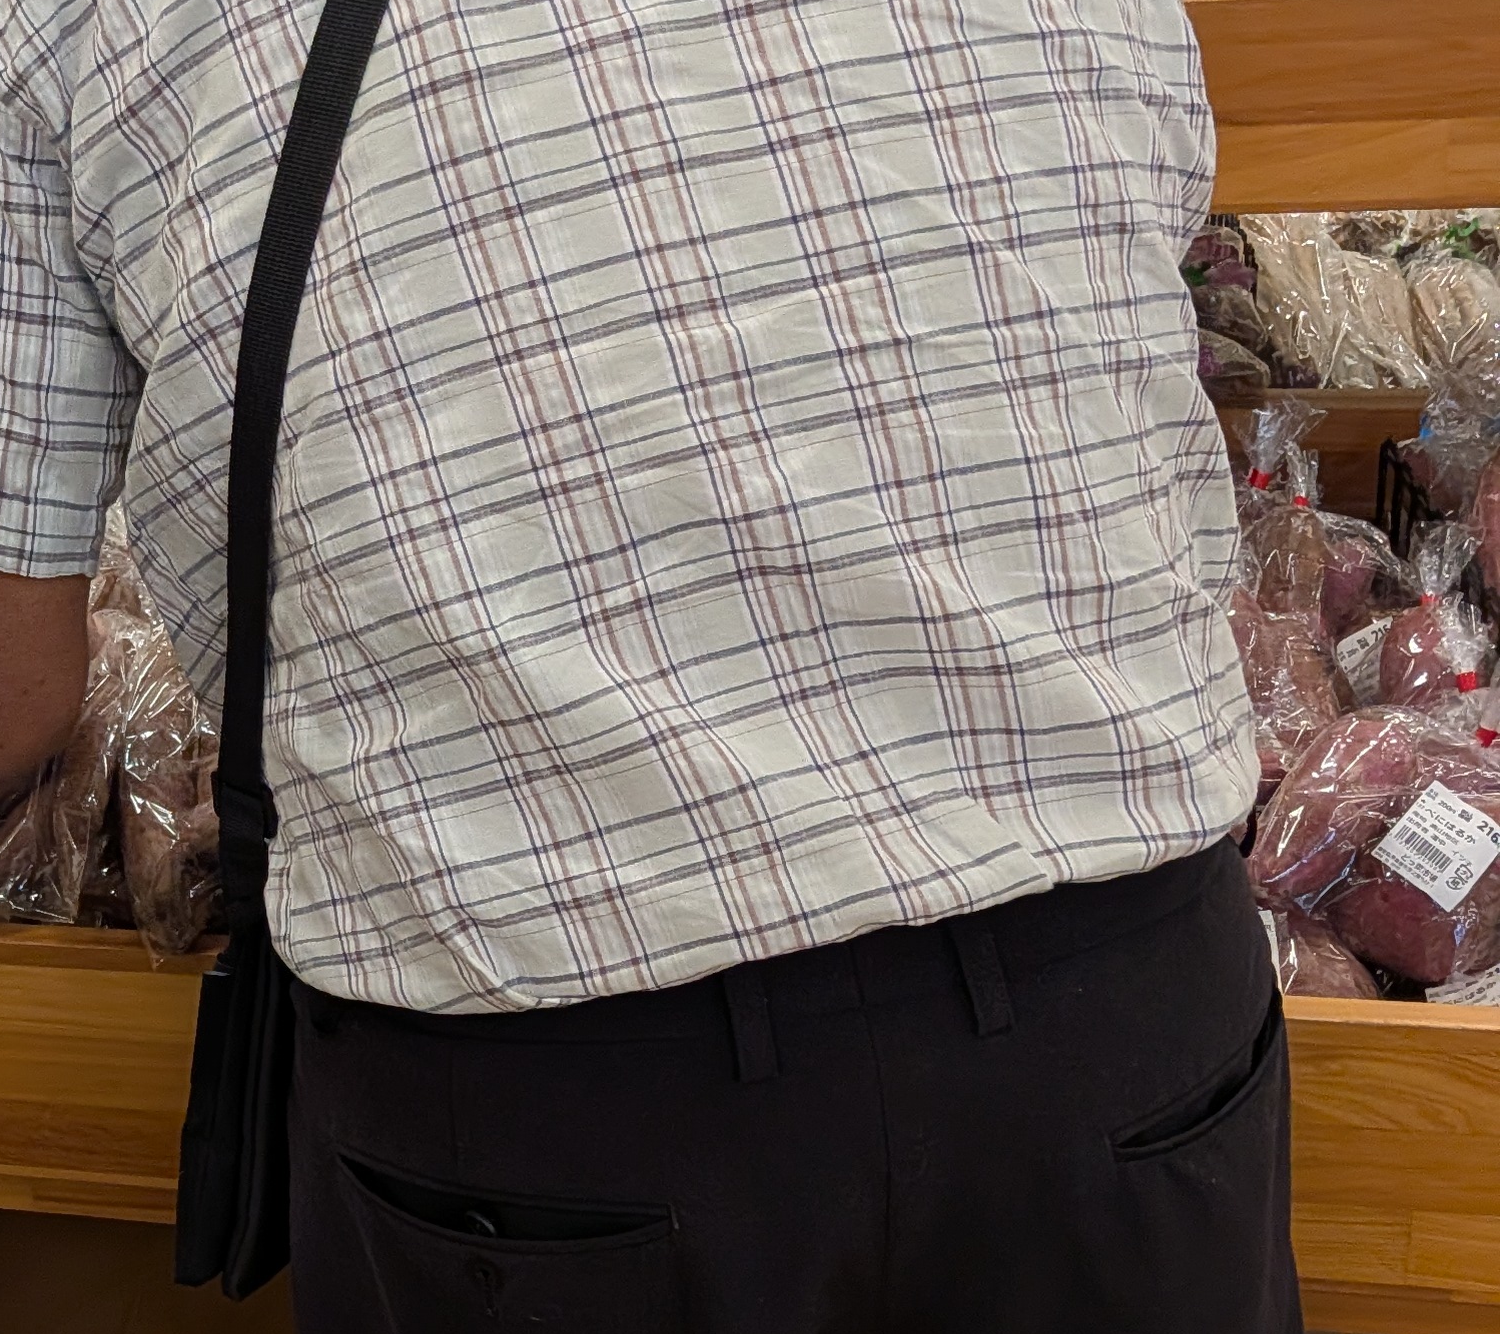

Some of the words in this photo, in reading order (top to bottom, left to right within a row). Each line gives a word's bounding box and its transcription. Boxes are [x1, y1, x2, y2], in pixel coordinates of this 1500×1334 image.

[1424, 804, 1478, 847] べにはるか
